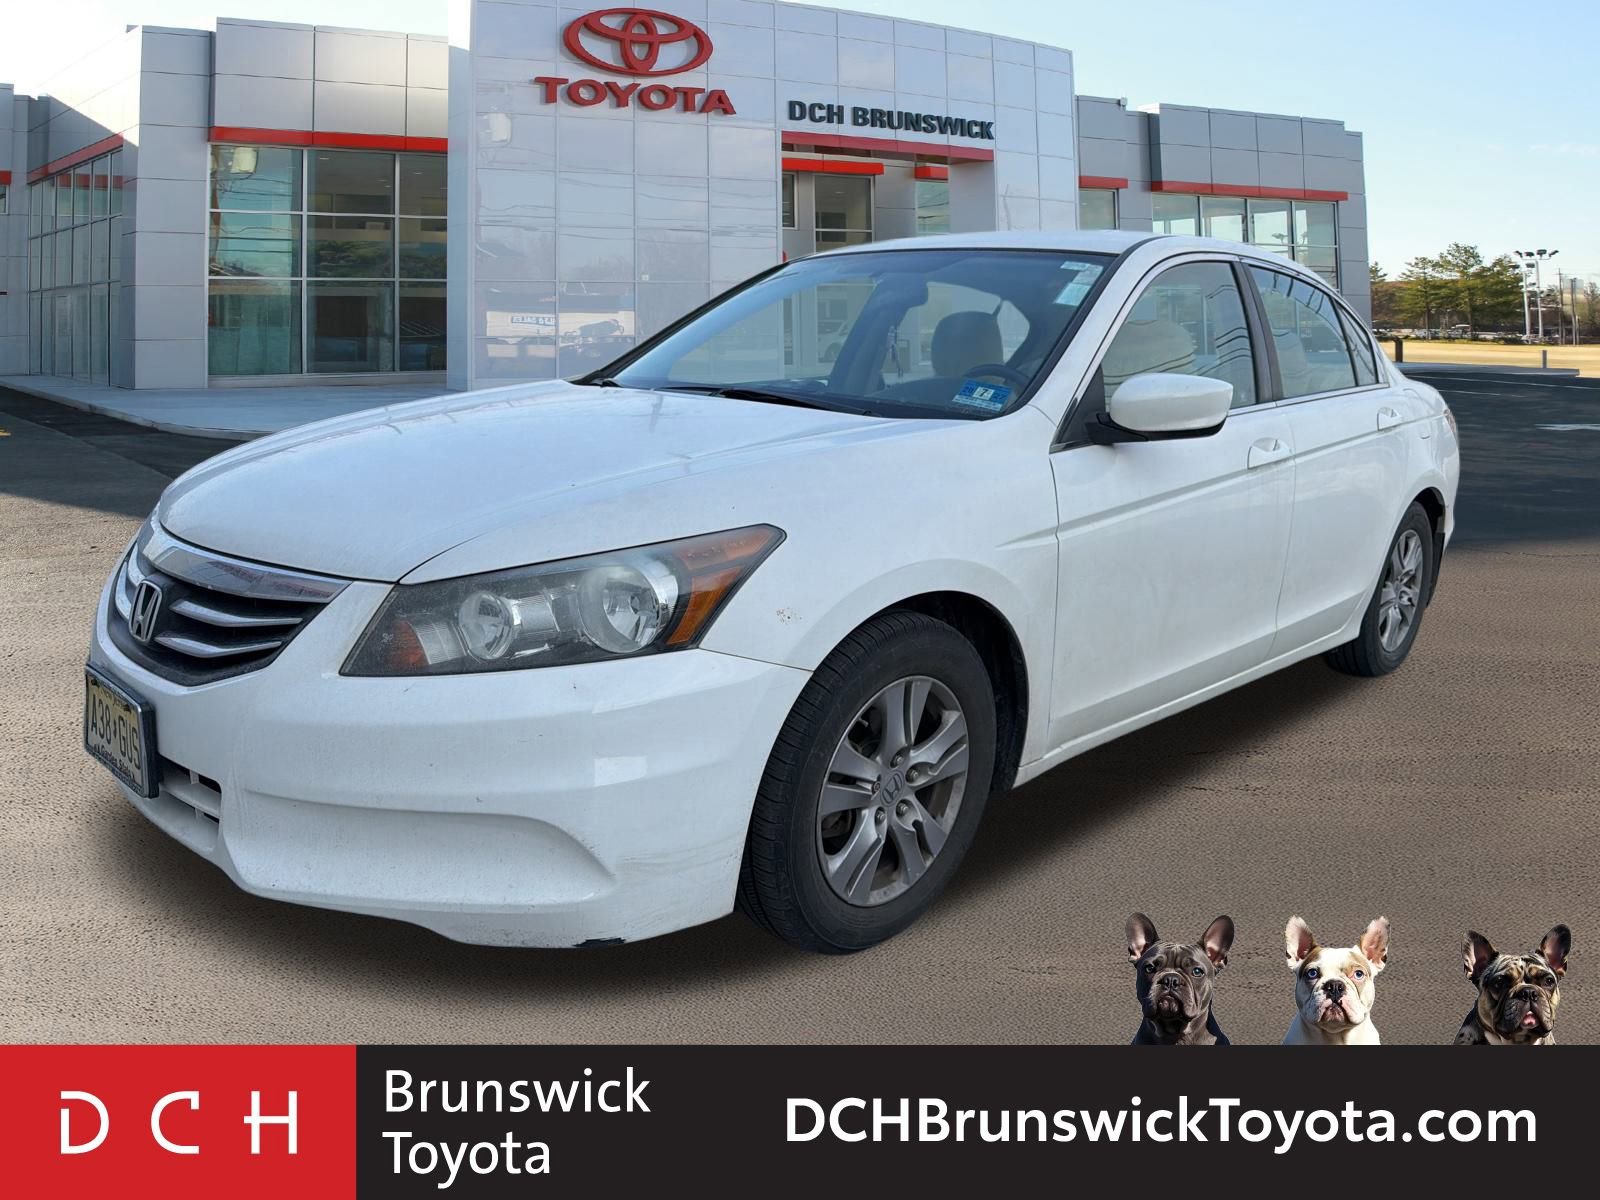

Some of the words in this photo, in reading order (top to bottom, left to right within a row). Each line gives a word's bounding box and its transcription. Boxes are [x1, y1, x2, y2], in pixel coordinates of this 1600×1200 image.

[534, 76, 737, 115] TOYOTA
[788, 100, 845, 125] DCH
[852, 106, 995, 140] BRUNSWICK
